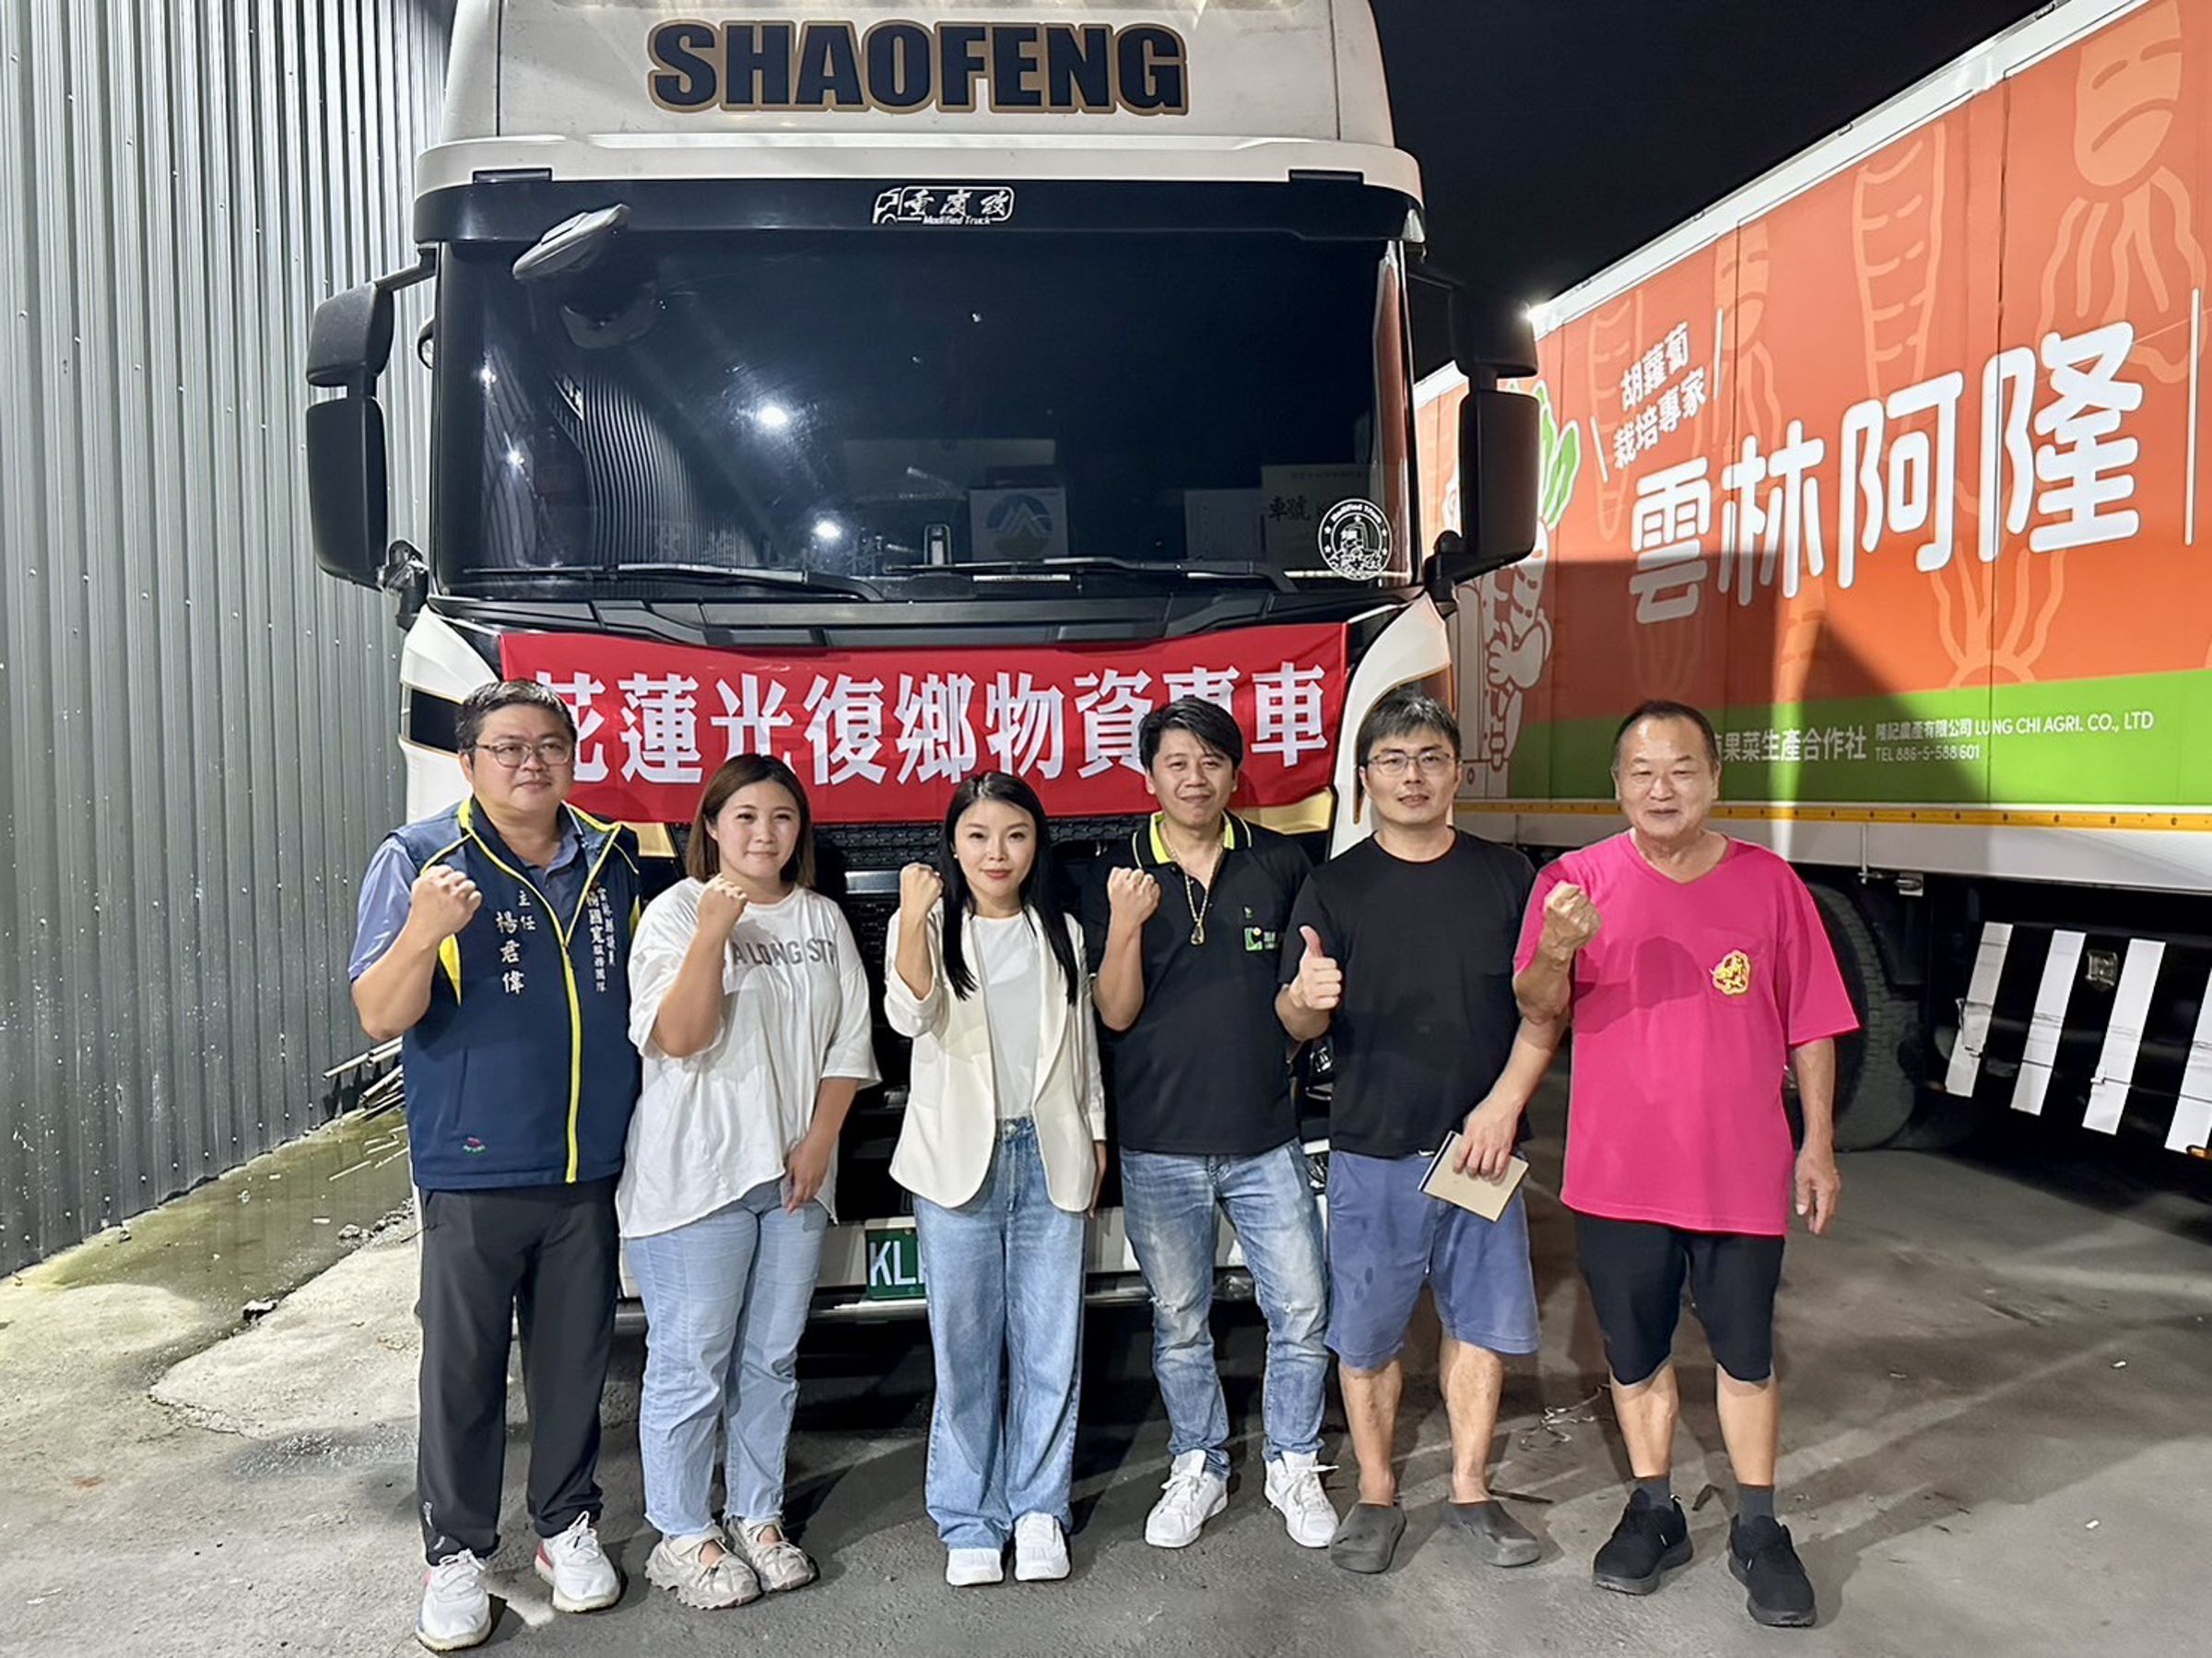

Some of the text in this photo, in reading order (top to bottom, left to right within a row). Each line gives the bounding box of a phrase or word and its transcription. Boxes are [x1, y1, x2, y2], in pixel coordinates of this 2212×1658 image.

[648, 19, 1188, 115] SHAOFENG
[923, 215, 991, 225] Modified Truck
[1620, 321, 1689, 412] 胡蘿蔔
[1613, 366, 1707, 470] 栽培專家
[1629, 321, 2144, 625] 雲林阿隆
[1975, 718, 2013, 735] LUNG
[2016, 716, 2041, 735] CHI
[2043, 714, 2084, 733] AGRI.
[2124, 711, 2154, 730] LTD
[1876, 747, 1893, 762] TEL
[518, 890, 536, 931] 主任
[870, 1241, 924, 1287] KL
